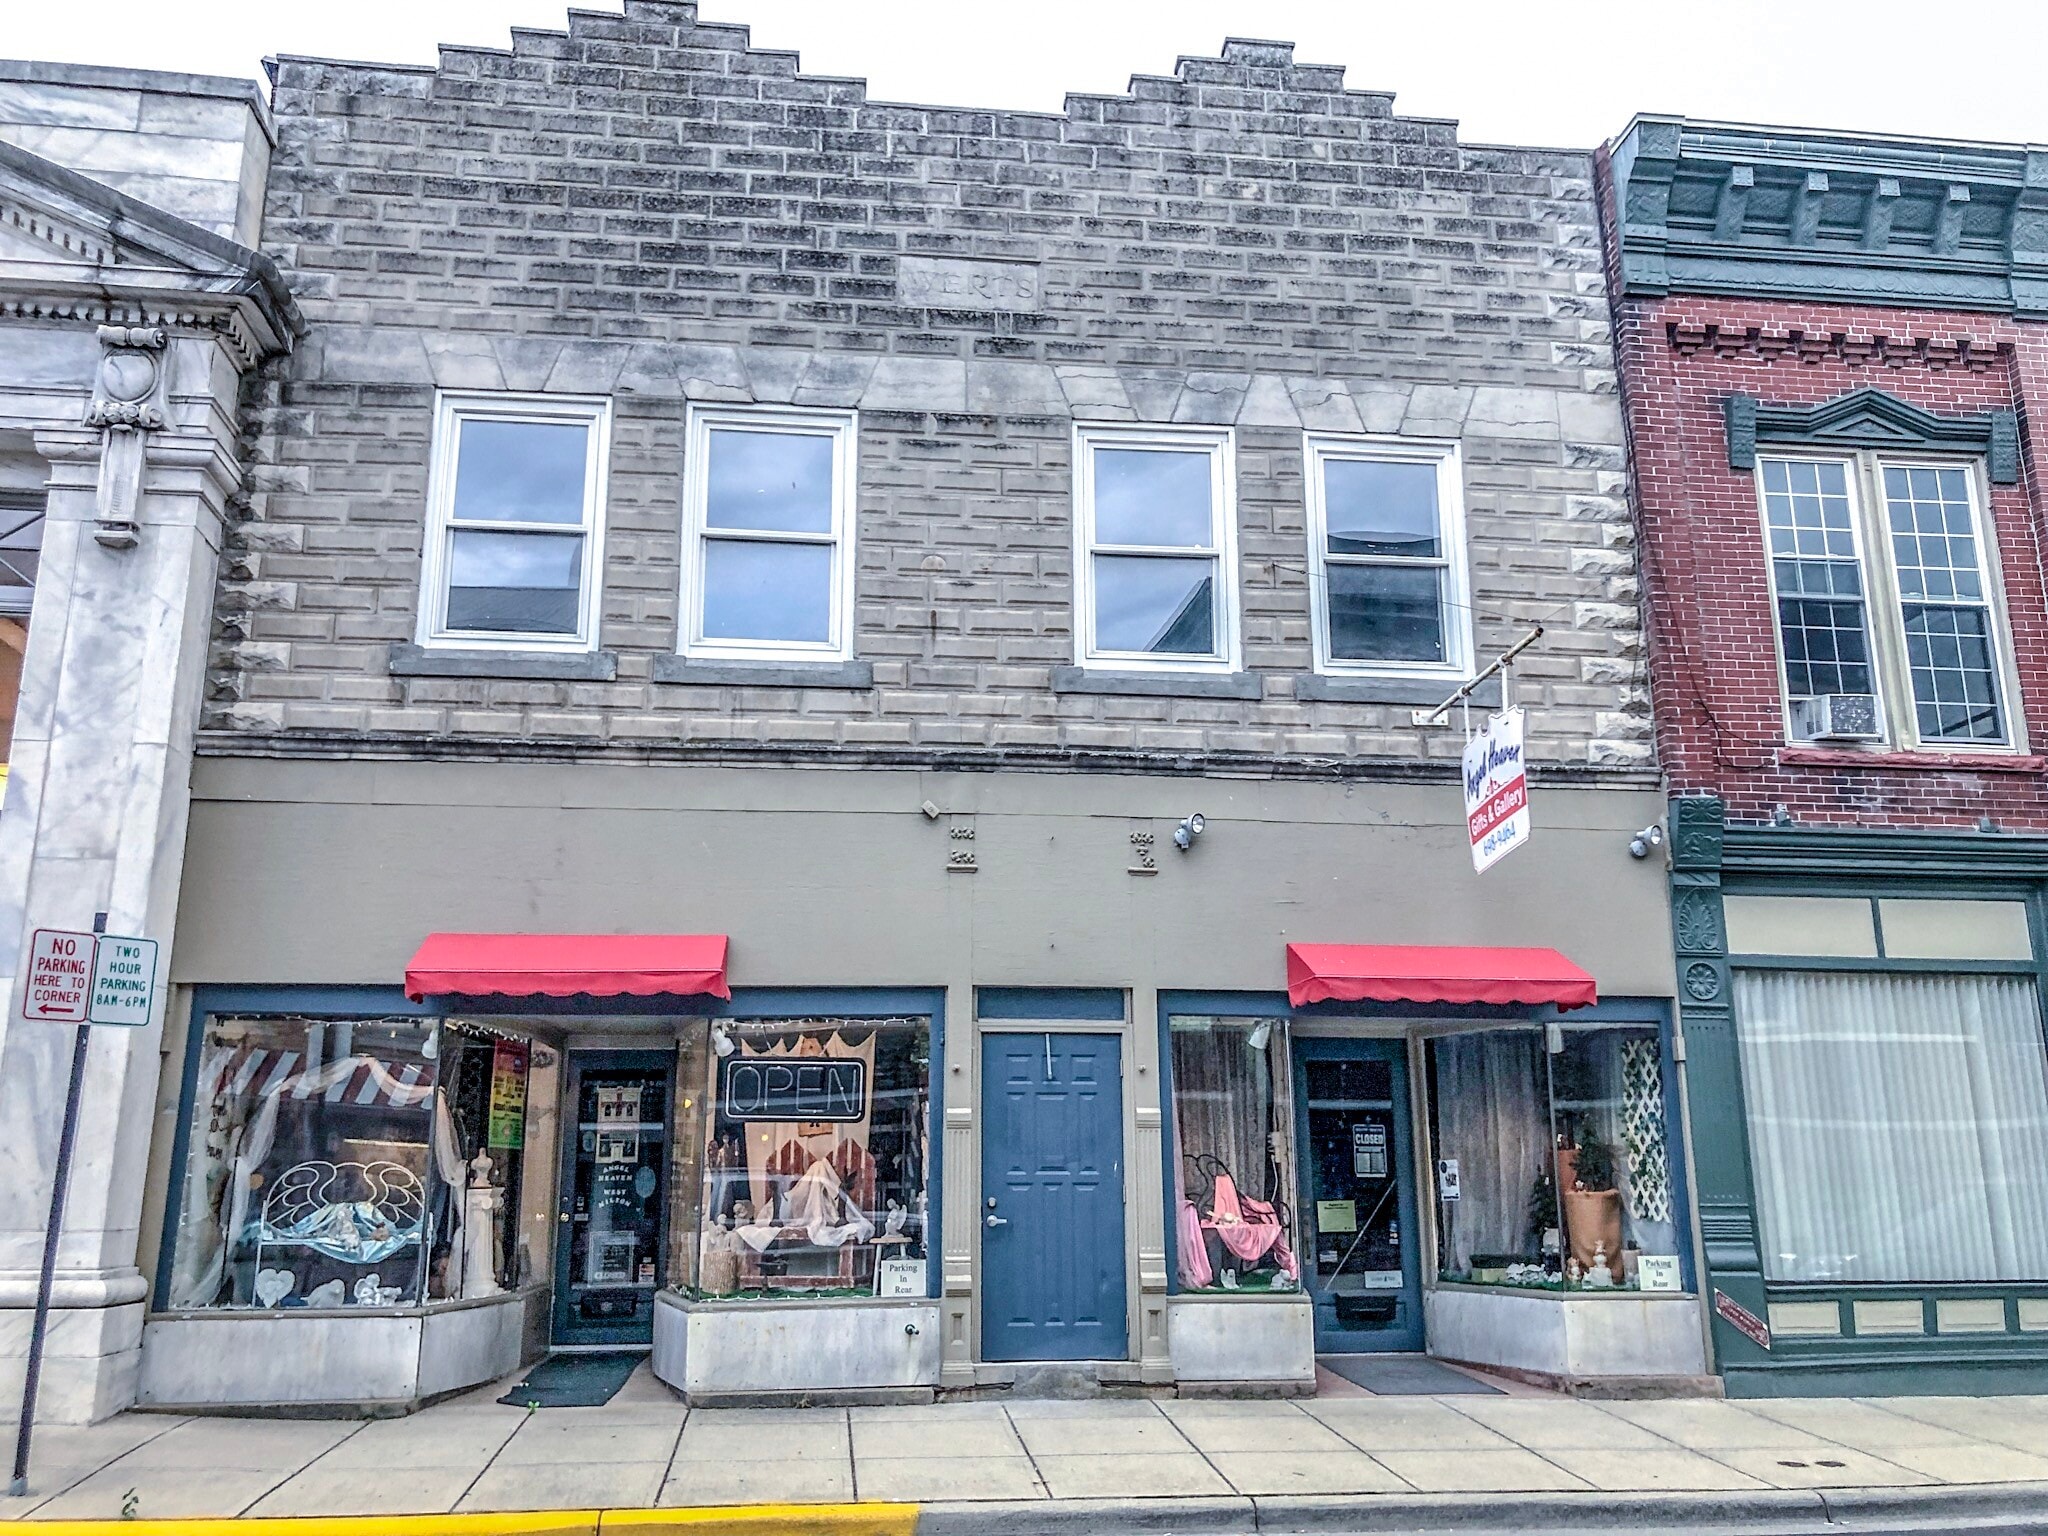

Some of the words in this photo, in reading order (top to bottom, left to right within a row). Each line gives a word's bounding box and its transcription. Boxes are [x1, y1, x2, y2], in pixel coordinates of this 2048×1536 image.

[1467, 750, 1487, 802] Angel
[1488, 738, 1521, 772] Heaven
[1470, 816, 1489, 837] Gifts
[1487, 805, 1495, 823] &
[1494, 786, 1523, 817] Gallery
[52, 938, 76, 955] NO
[116, 945, 140, 958] TWO
[37, 957, 86, 974] PARKING
[109, 962, 141, 975] HOUR
[34, 975, 62, 987] HERE
[71, 977, 85, 989] TO
[100, 978, 146, 992] PARKING
[34, 990, 80, 1003] CORNER
[96, 994, 147, 1008] 8AM-6PM
[732, 1066, 857, 1112] OPEN
[1355, 1133, 1384, 1145] CLOSED
[603, 1164, 630, 1174] ANGEL
[890, 1264, 918, 1273] Parking
[1645, 1259, 1672, 1269] Parking
